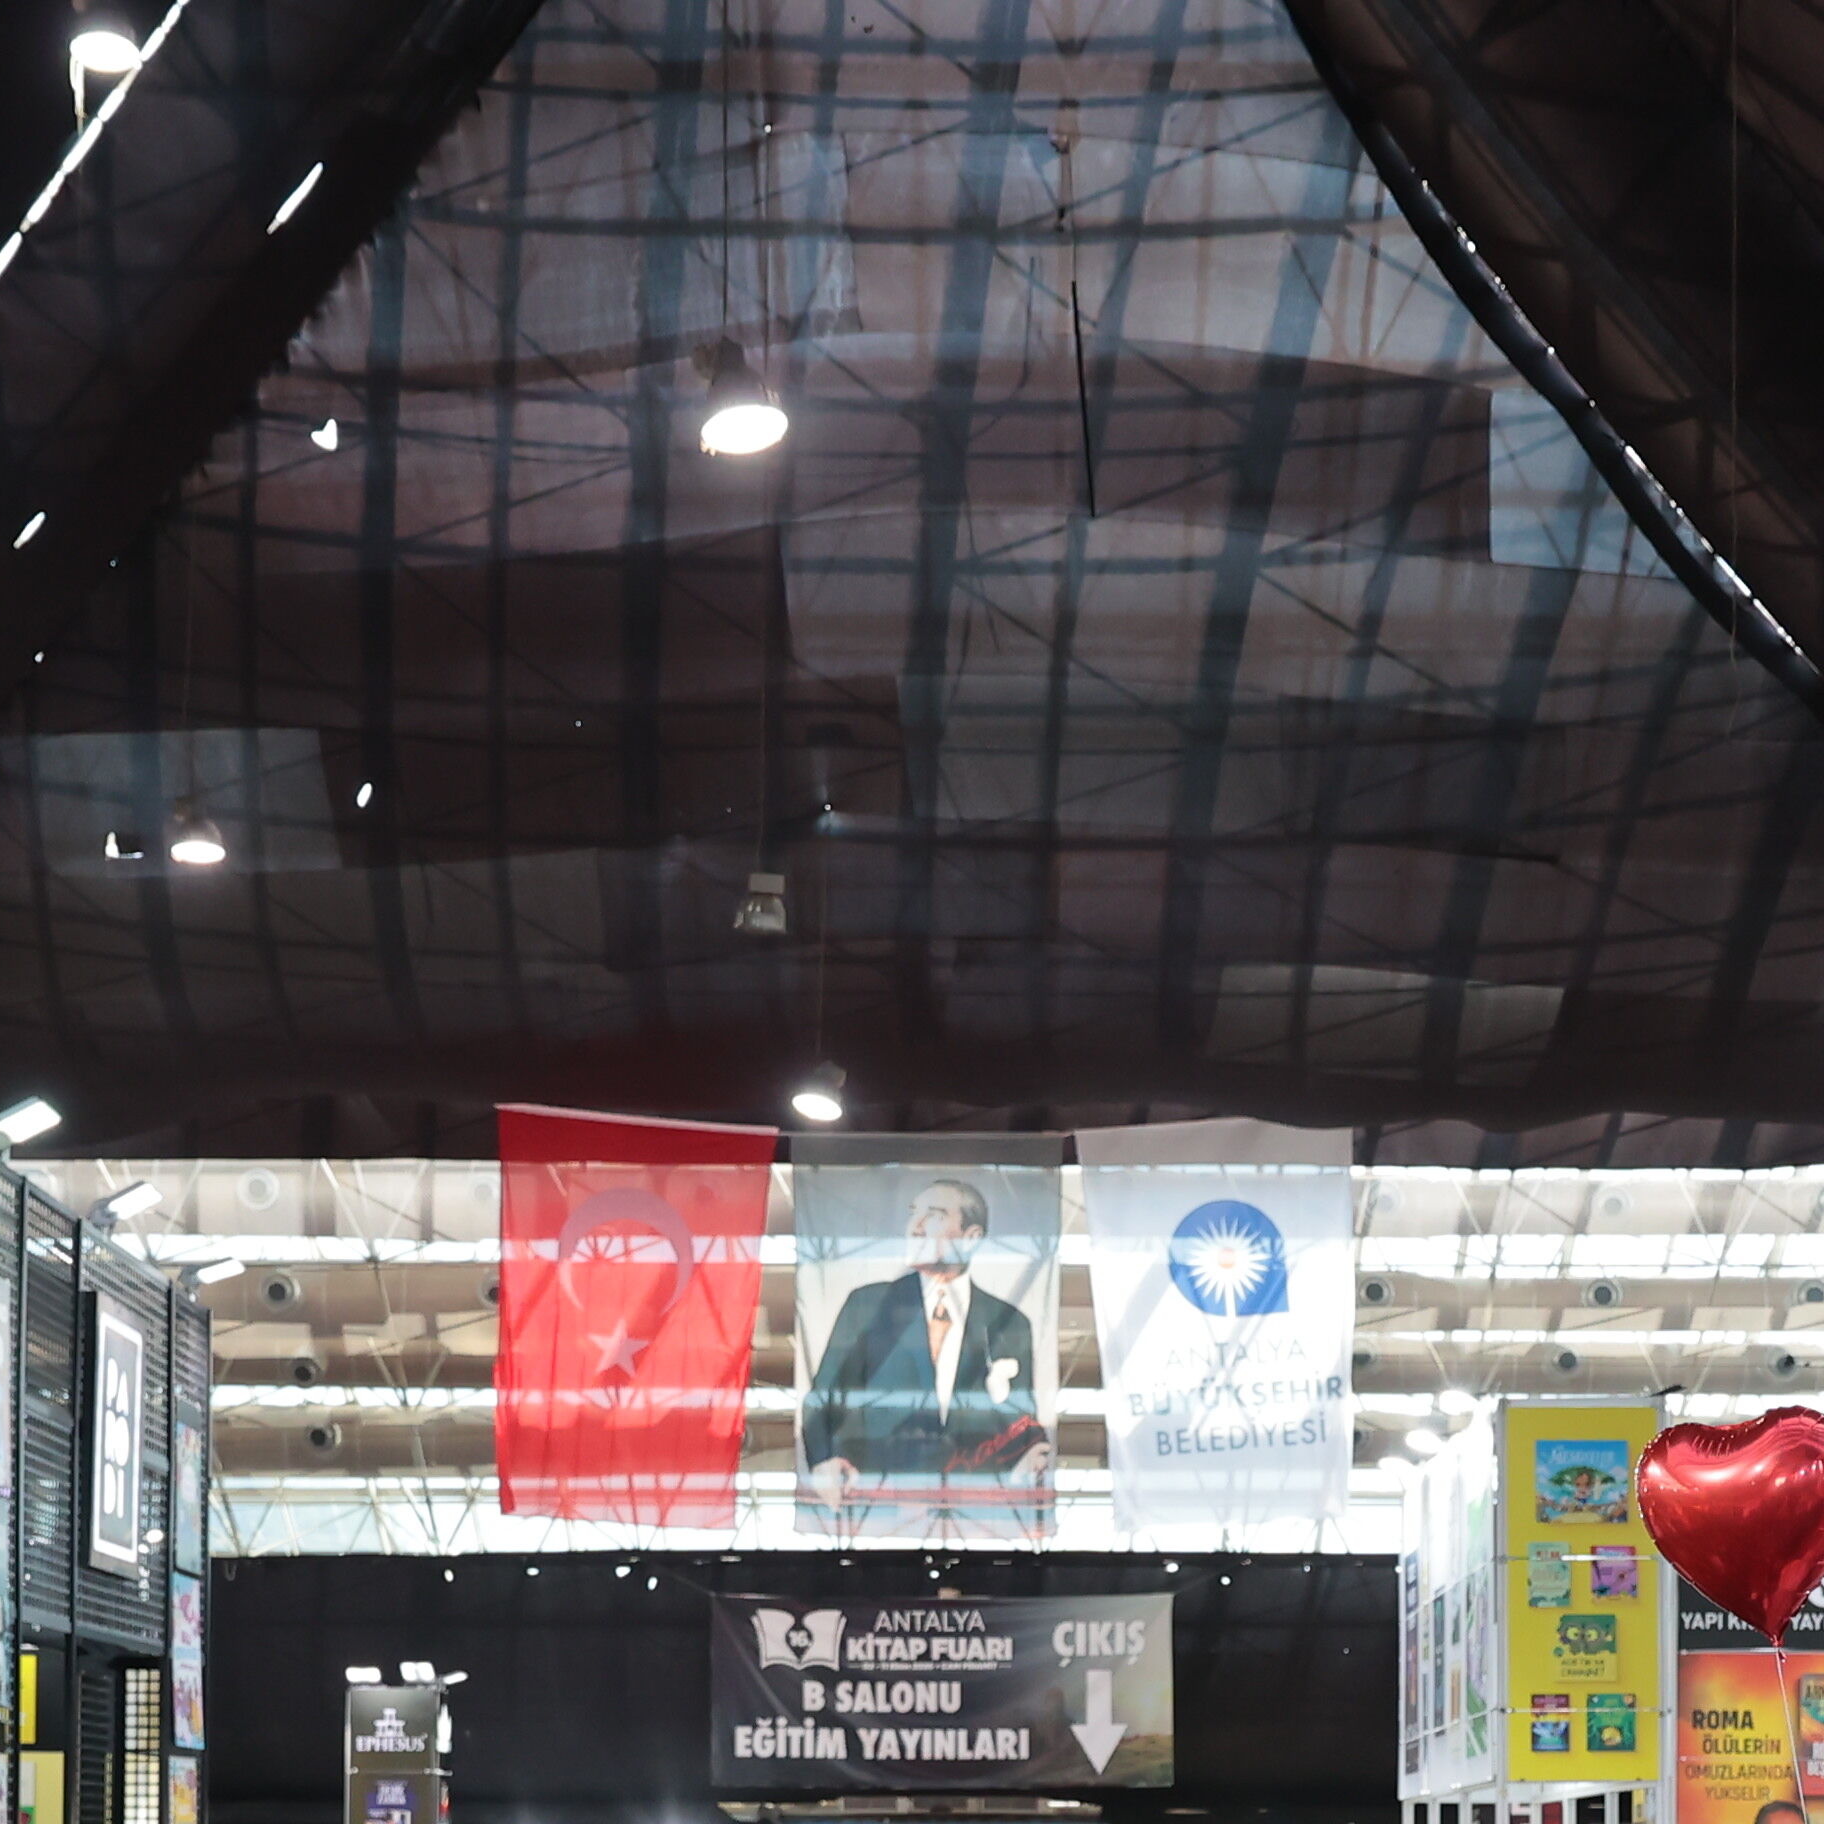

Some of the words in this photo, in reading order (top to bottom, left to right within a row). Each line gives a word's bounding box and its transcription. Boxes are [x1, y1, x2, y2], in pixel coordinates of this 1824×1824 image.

[1157, 1411, 1326, 1456] BELEDİYESİ
[874, 1610, 986, 1633] ANTALYA
[1682, 1613, 1722, 1631] YAPI
[846, 1633, 928, 1662] KİTAP
[931, 1637, 1014, 1662] FUARI
[1052, 1620, 1145, 1667] ÇIKIŞ
[802, 1681, 826, 1713] B
[836, 1680, 961, 1714] SALONU
[1692, 1710, 1755, 1730] ROMA
[356, 1736, 425, 1752] EPHESUS
[734, 1717, 848, 1760] EĞİTİM
[859, 1727, 1030, 1761] YAYINLARI
[1703, 1734, 1782, 1755] ÖLÜLERİN
[1685, 1764, 1795, 1781] OMUZLARINDA
